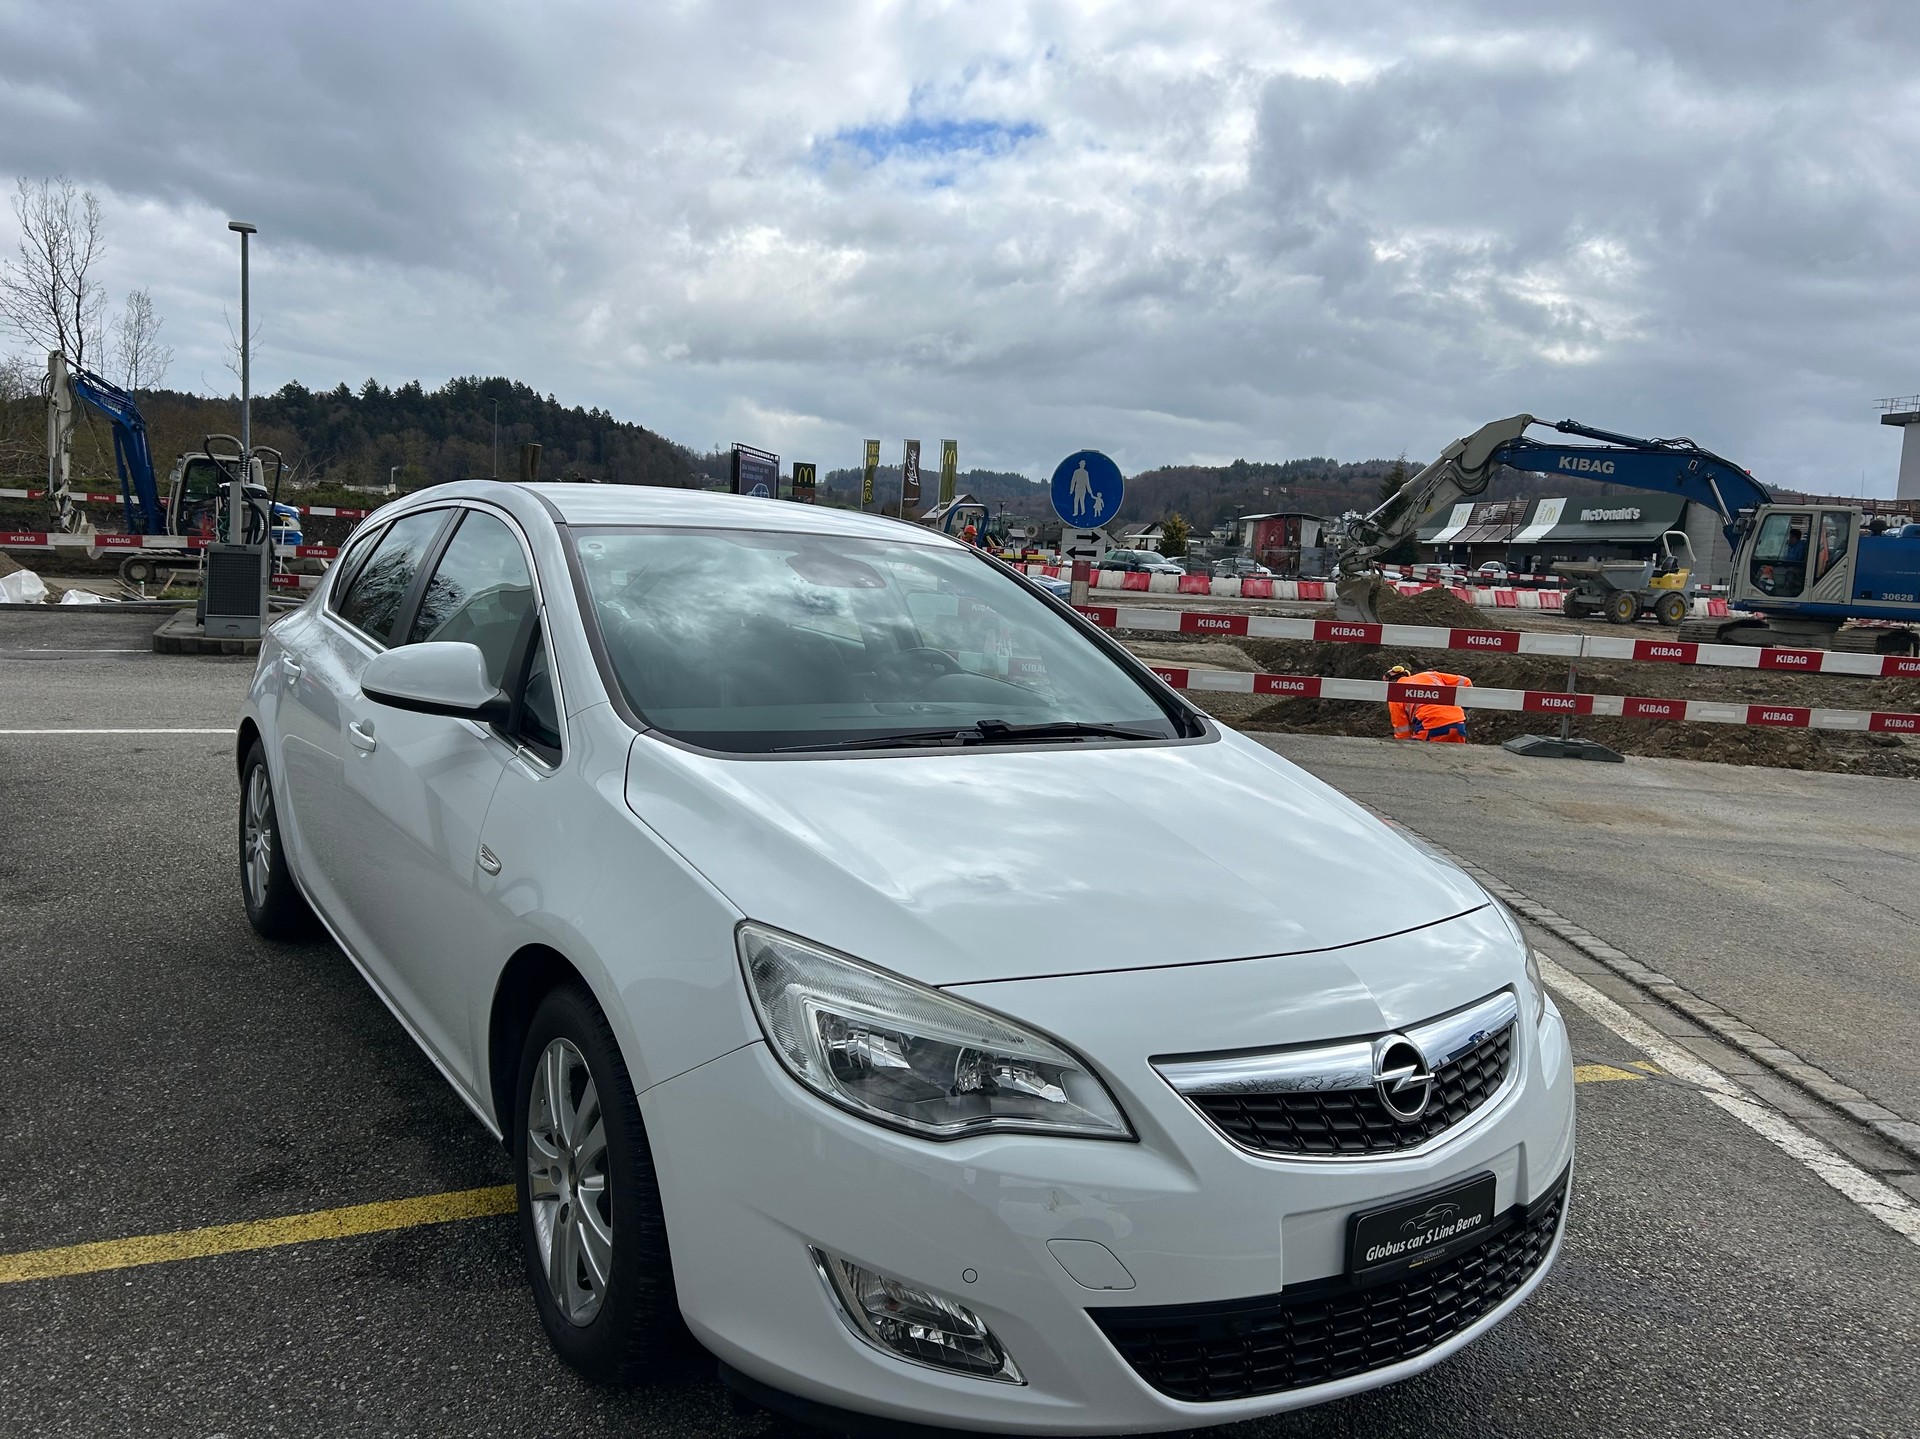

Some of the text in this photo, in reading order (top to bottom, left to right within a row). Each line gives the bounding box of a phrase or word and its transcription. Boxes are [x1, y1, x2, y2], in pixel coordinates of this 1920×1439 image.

[1559, 456, 1615, 474] KIBAG
[1580, 508, 1641, 521] McDonald's
[1881, 592, 1914, 601] 30628
[1197, 619, 1231, 629] KIBAG
[1331, 627, 1365, 637] KIBAG
[1467, 636, 1502, 646] KIBAG
[1650, 646, 1682, 657] KIBAG
[1776, 654, 1808, 664] KIBAG
[1898, 662, 1920, 671] KIBA
[1271, 680, 1305, 691] KIBAG
[1405, 689, 1440, 699] KIBAG
[1541, 697, 1575, 708] KIBAG
[1638, 703, 1670, 714] KIBAG
[1762, 711, 1794, 722] KIBAG
[1884, 718, 1915, 728] KIBAG
[1366, 1241, 1406, 1262] Globus
[1407, 1234, 1426, 1249] car
[1425, 1229, 1434, 1244] S
[1433, 1225, 1455, 1241] Line
[1455, 1213, 1482, 1233] Berro
